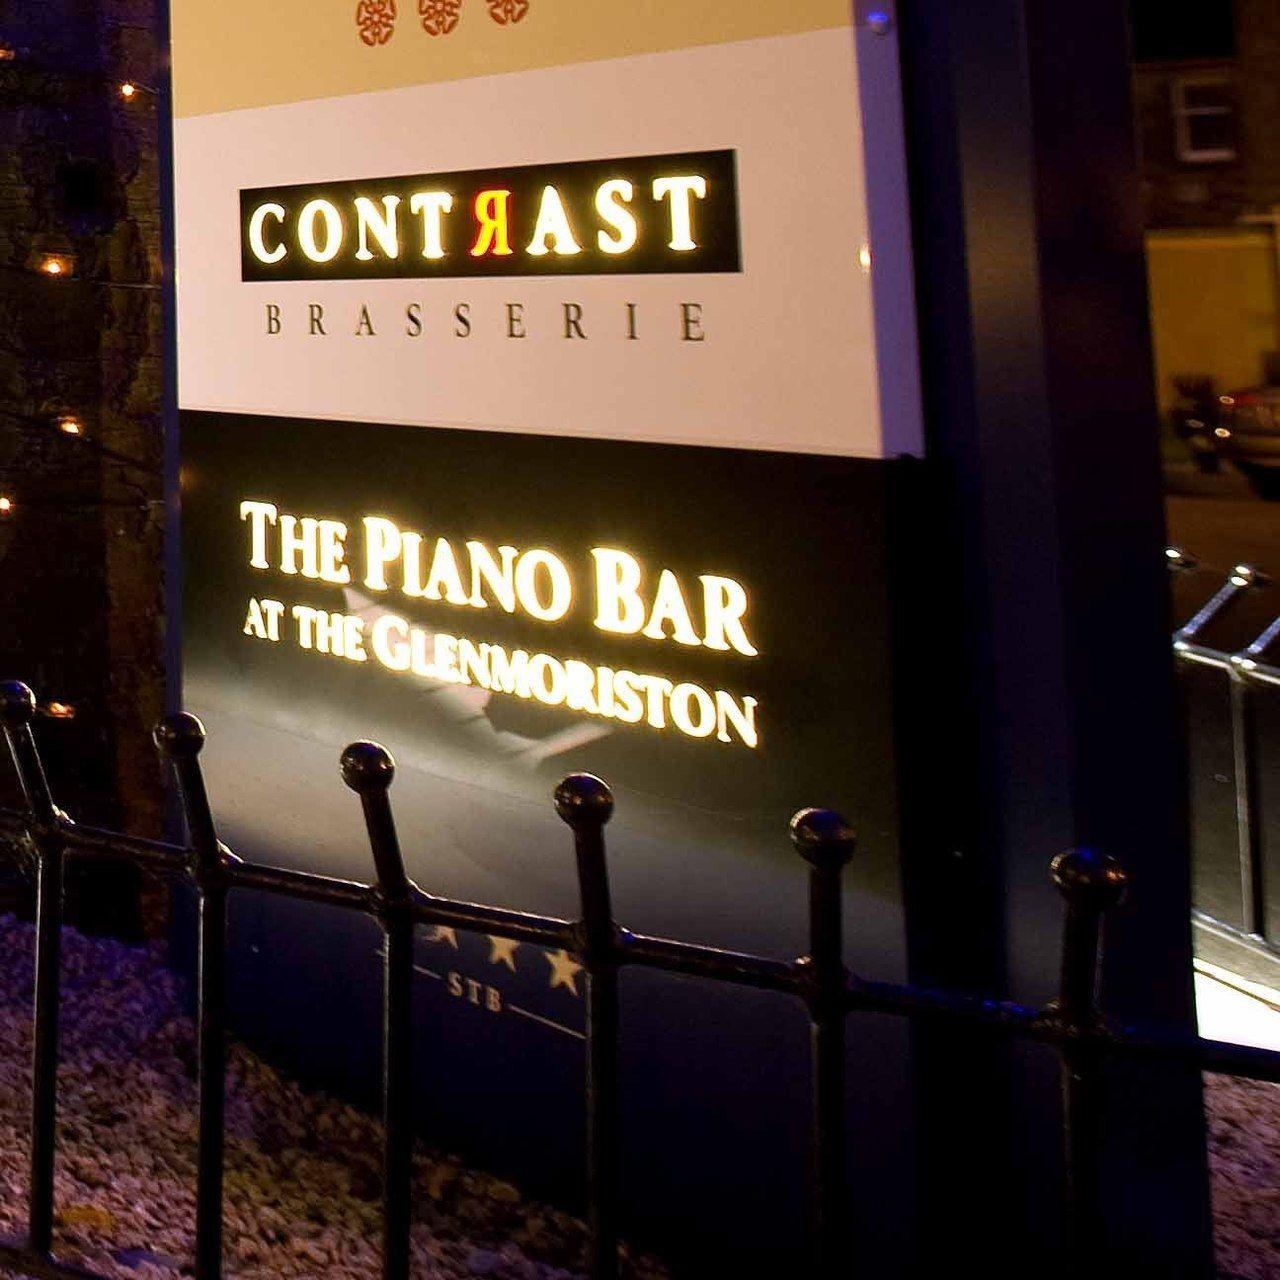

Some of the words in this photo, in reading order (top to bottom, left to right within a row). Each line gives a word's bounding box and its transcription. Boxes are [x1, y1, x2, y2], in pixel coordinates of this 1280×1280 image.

[264, 302, 707, 343] BRASSERIE
[240, 500, 350, 586] THE
[362, 516, 573, 622] PIANO
[590, 546, 760, 658] BAR
[243, 596, 284, 642] AT
[292, 606, 367, 663] THE
[369, 613, 760, 749] GLENMORISTON
[446, 970, 504, 1014] STB
